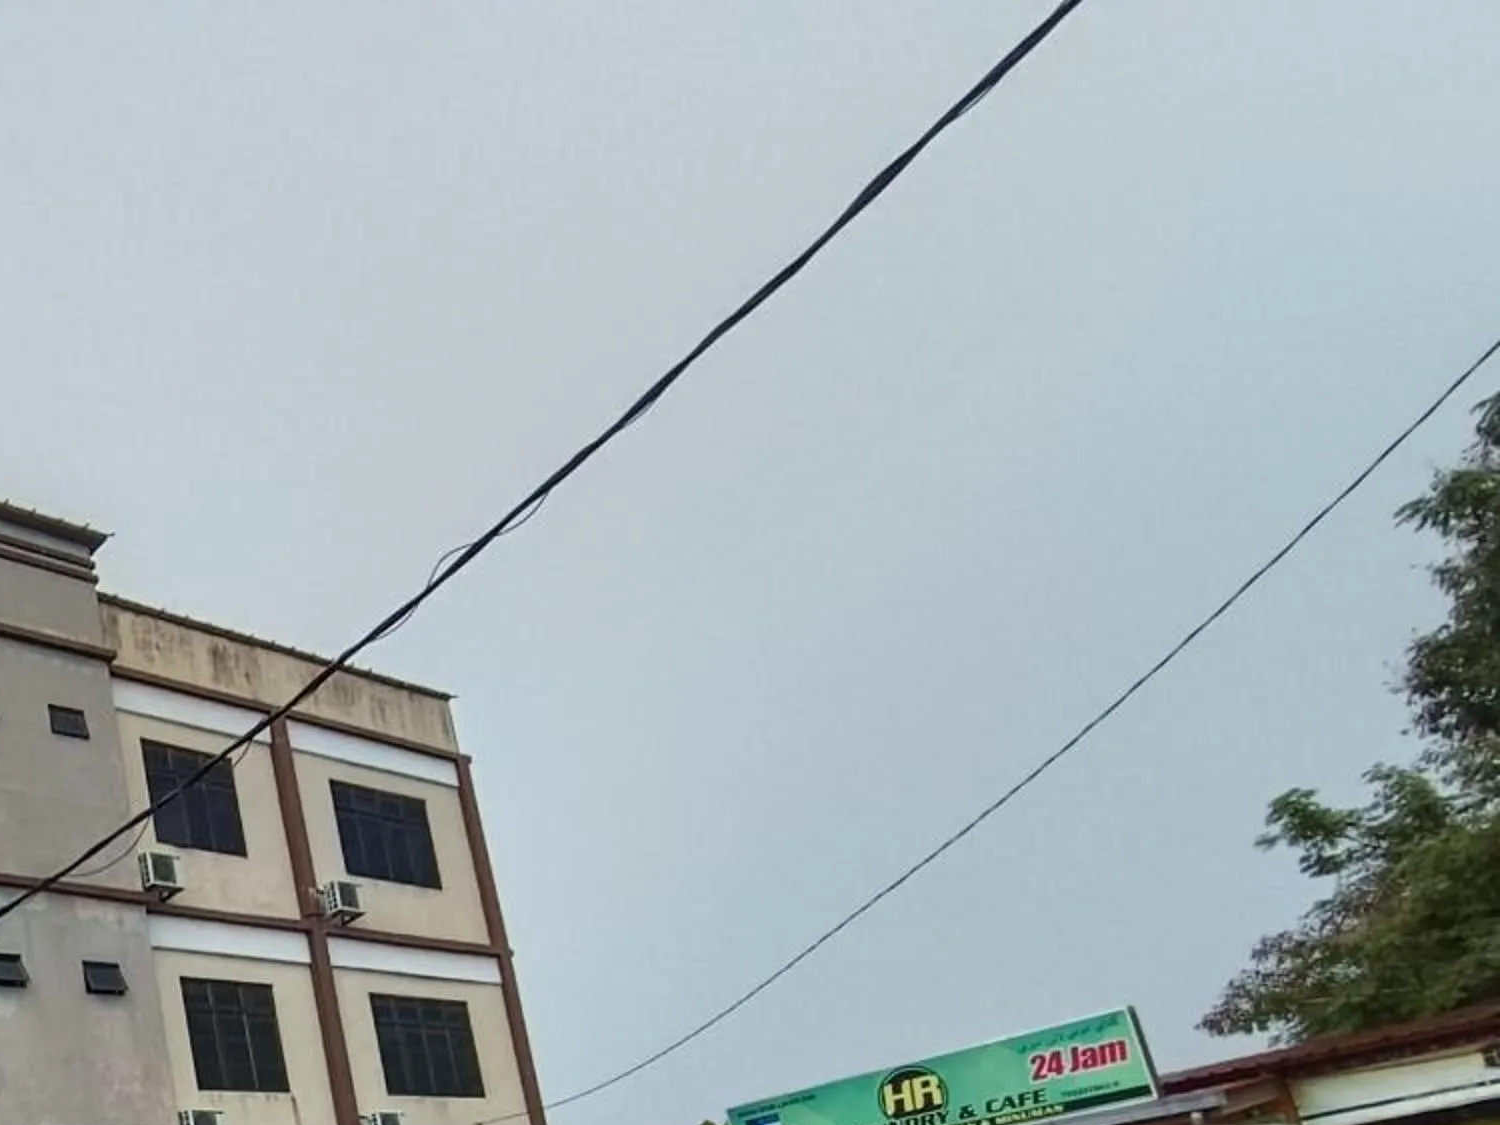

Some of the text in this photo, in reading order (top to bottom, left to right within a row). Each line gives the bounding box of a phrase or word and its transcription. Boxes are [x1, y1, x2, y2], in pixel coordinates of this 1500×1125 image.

[1030, 1040, 1127, 1081] 24 Jam
[884, 1074, 942, 1116] HR
[959, 1104, 977, 1120] &
[986, 1088, 1047, 1113] CAFE
